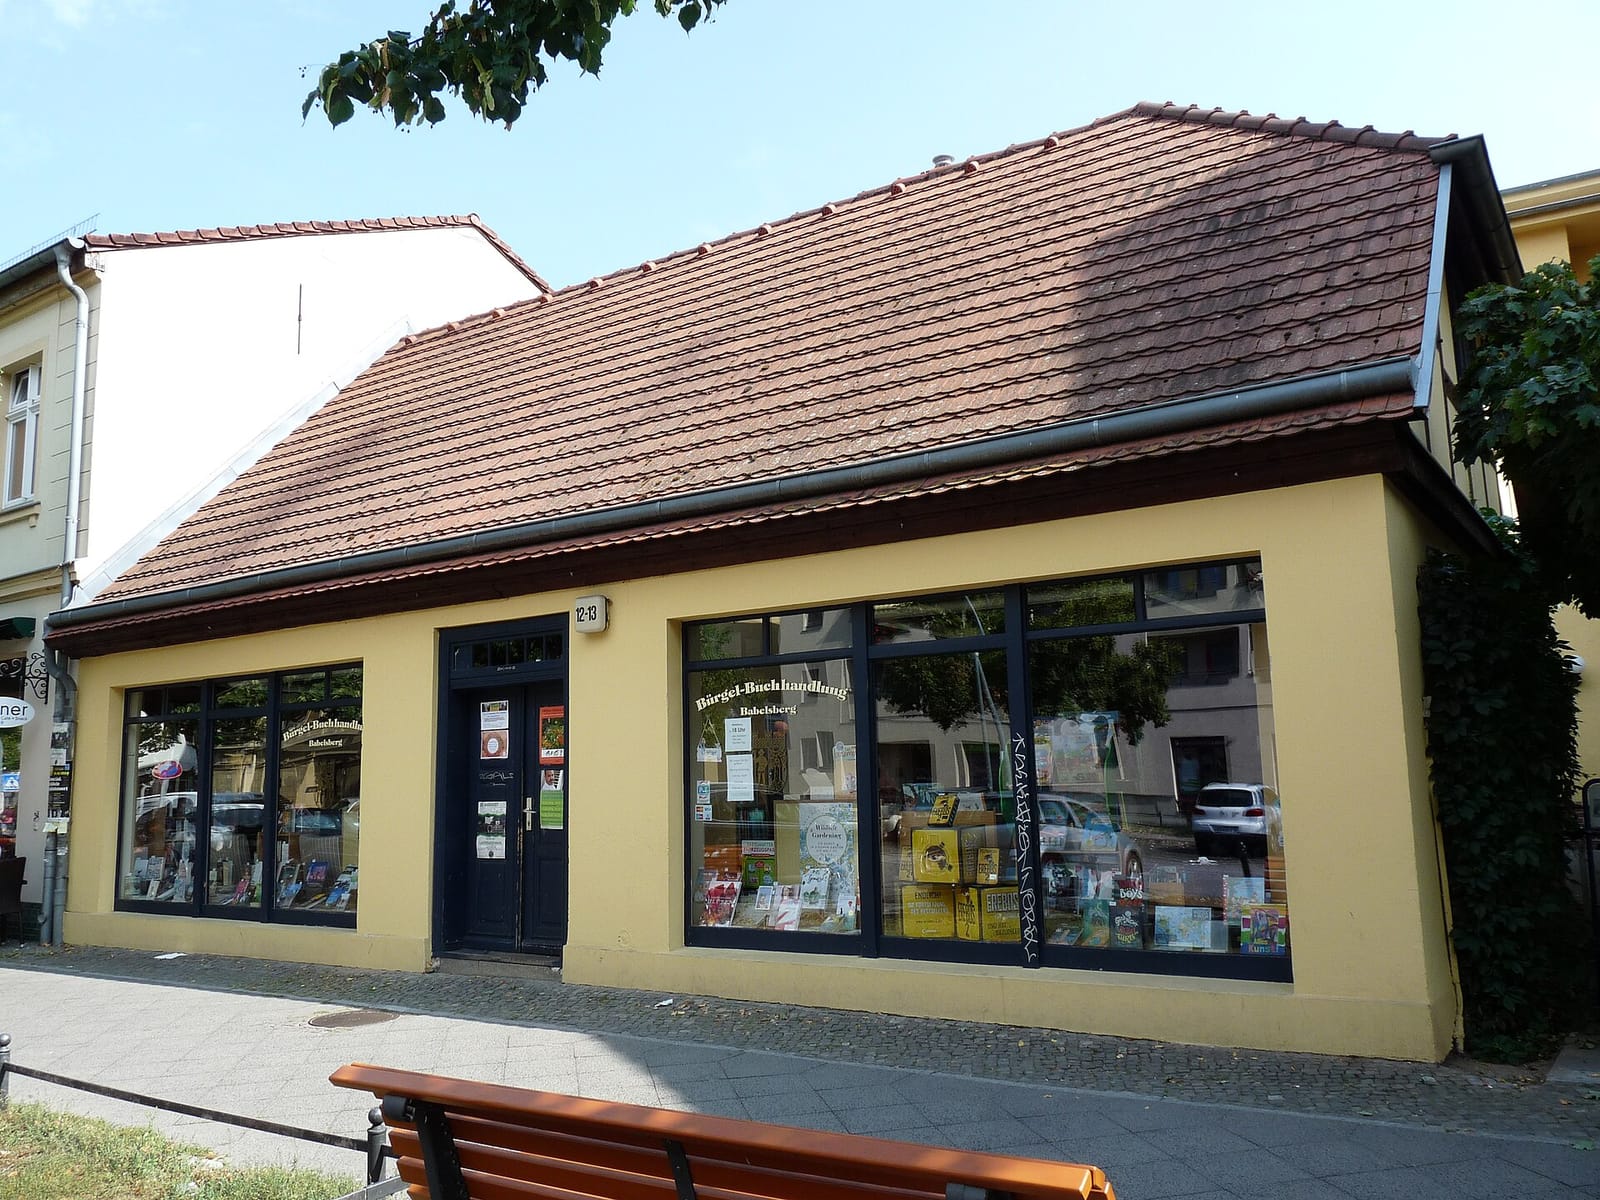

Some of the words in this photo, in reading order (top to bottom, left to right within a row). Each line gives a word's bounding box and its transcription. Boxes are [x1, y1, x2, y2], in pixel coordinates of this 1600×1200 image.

[575, 605, 597, 623] 12-13
[695, 678, 849, 712] Bürgel-Buchhandlung
[740, 704, 798, 717] Babelsberg
[282, 718, 363, 742] Bürgel-Buchhandlu
[308, 738, 343, 748] Babelsberg
[986, 891, 1020, 913] EREBOS
